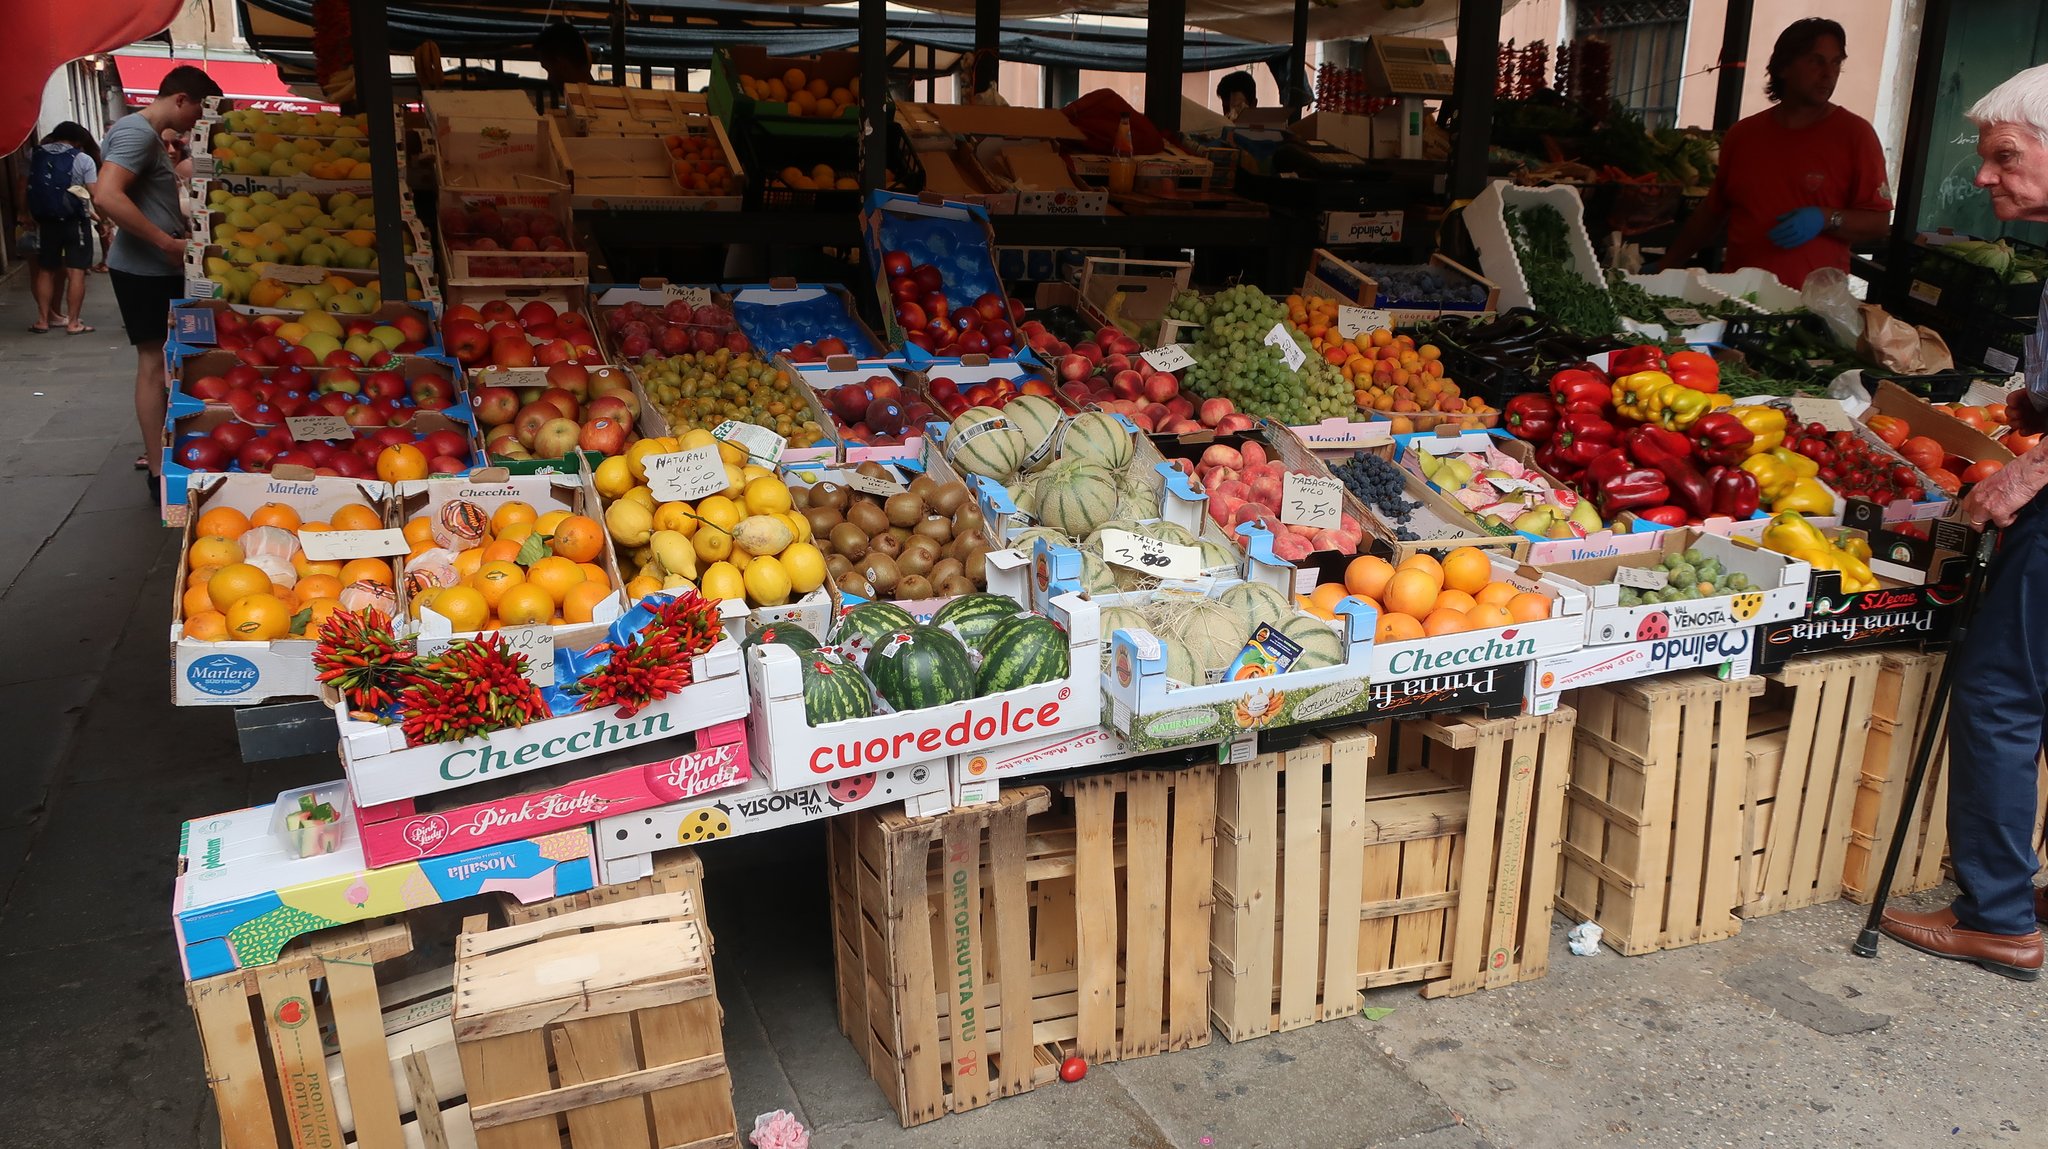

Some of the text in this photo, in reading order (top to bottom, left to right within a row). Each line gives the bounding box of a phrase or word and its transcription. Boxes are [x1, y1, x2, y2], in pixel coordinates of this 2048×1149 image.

[655, 453, 708, 470] NATURALI
[675, 465, 703, 474] KILO
[459, 486, 520, 497] Checchin
[667, 472, 715, 492] 5.00
[684, 482, 724, 498] ITALIA
[1300, 486, 1324, 496] KILO
[1291, 501, 1337, 521] 3.50
[1127, 535, 1163, 548] ITALIA
[1674, 611, 1726, 628] VENOSTA
[1675, 606, 1688, 614] VAL
[1792, 610, 1934, 640] Prima frutta
[1388, 629, 1534, 674] Checchin
[1650, 630, 1749, 670] Melinda
[191, 667, 256, 679] Marlene
[1400, 669, 1498, 698] Prima
[439, 708, 675, 781] Checchin
[1040, 745, 1068, 757] Mela
[660, 746, 738, 786] Pink
[680, 764, 742, 800] Lady
[737, 788, 822, 817] VENOSTA
[801, 803, 823, 816] VAL
[455, 790, 608, 837] Pink Lady
[411, 820, 438, 841] Pink
[419, 830, 445, 847] Lady
[447, 853, 518, 881] Mosaila
[952, 869, 975, 1006] ORTOFRUTTA
[290, 1072, 311, 1122] LOTTA
